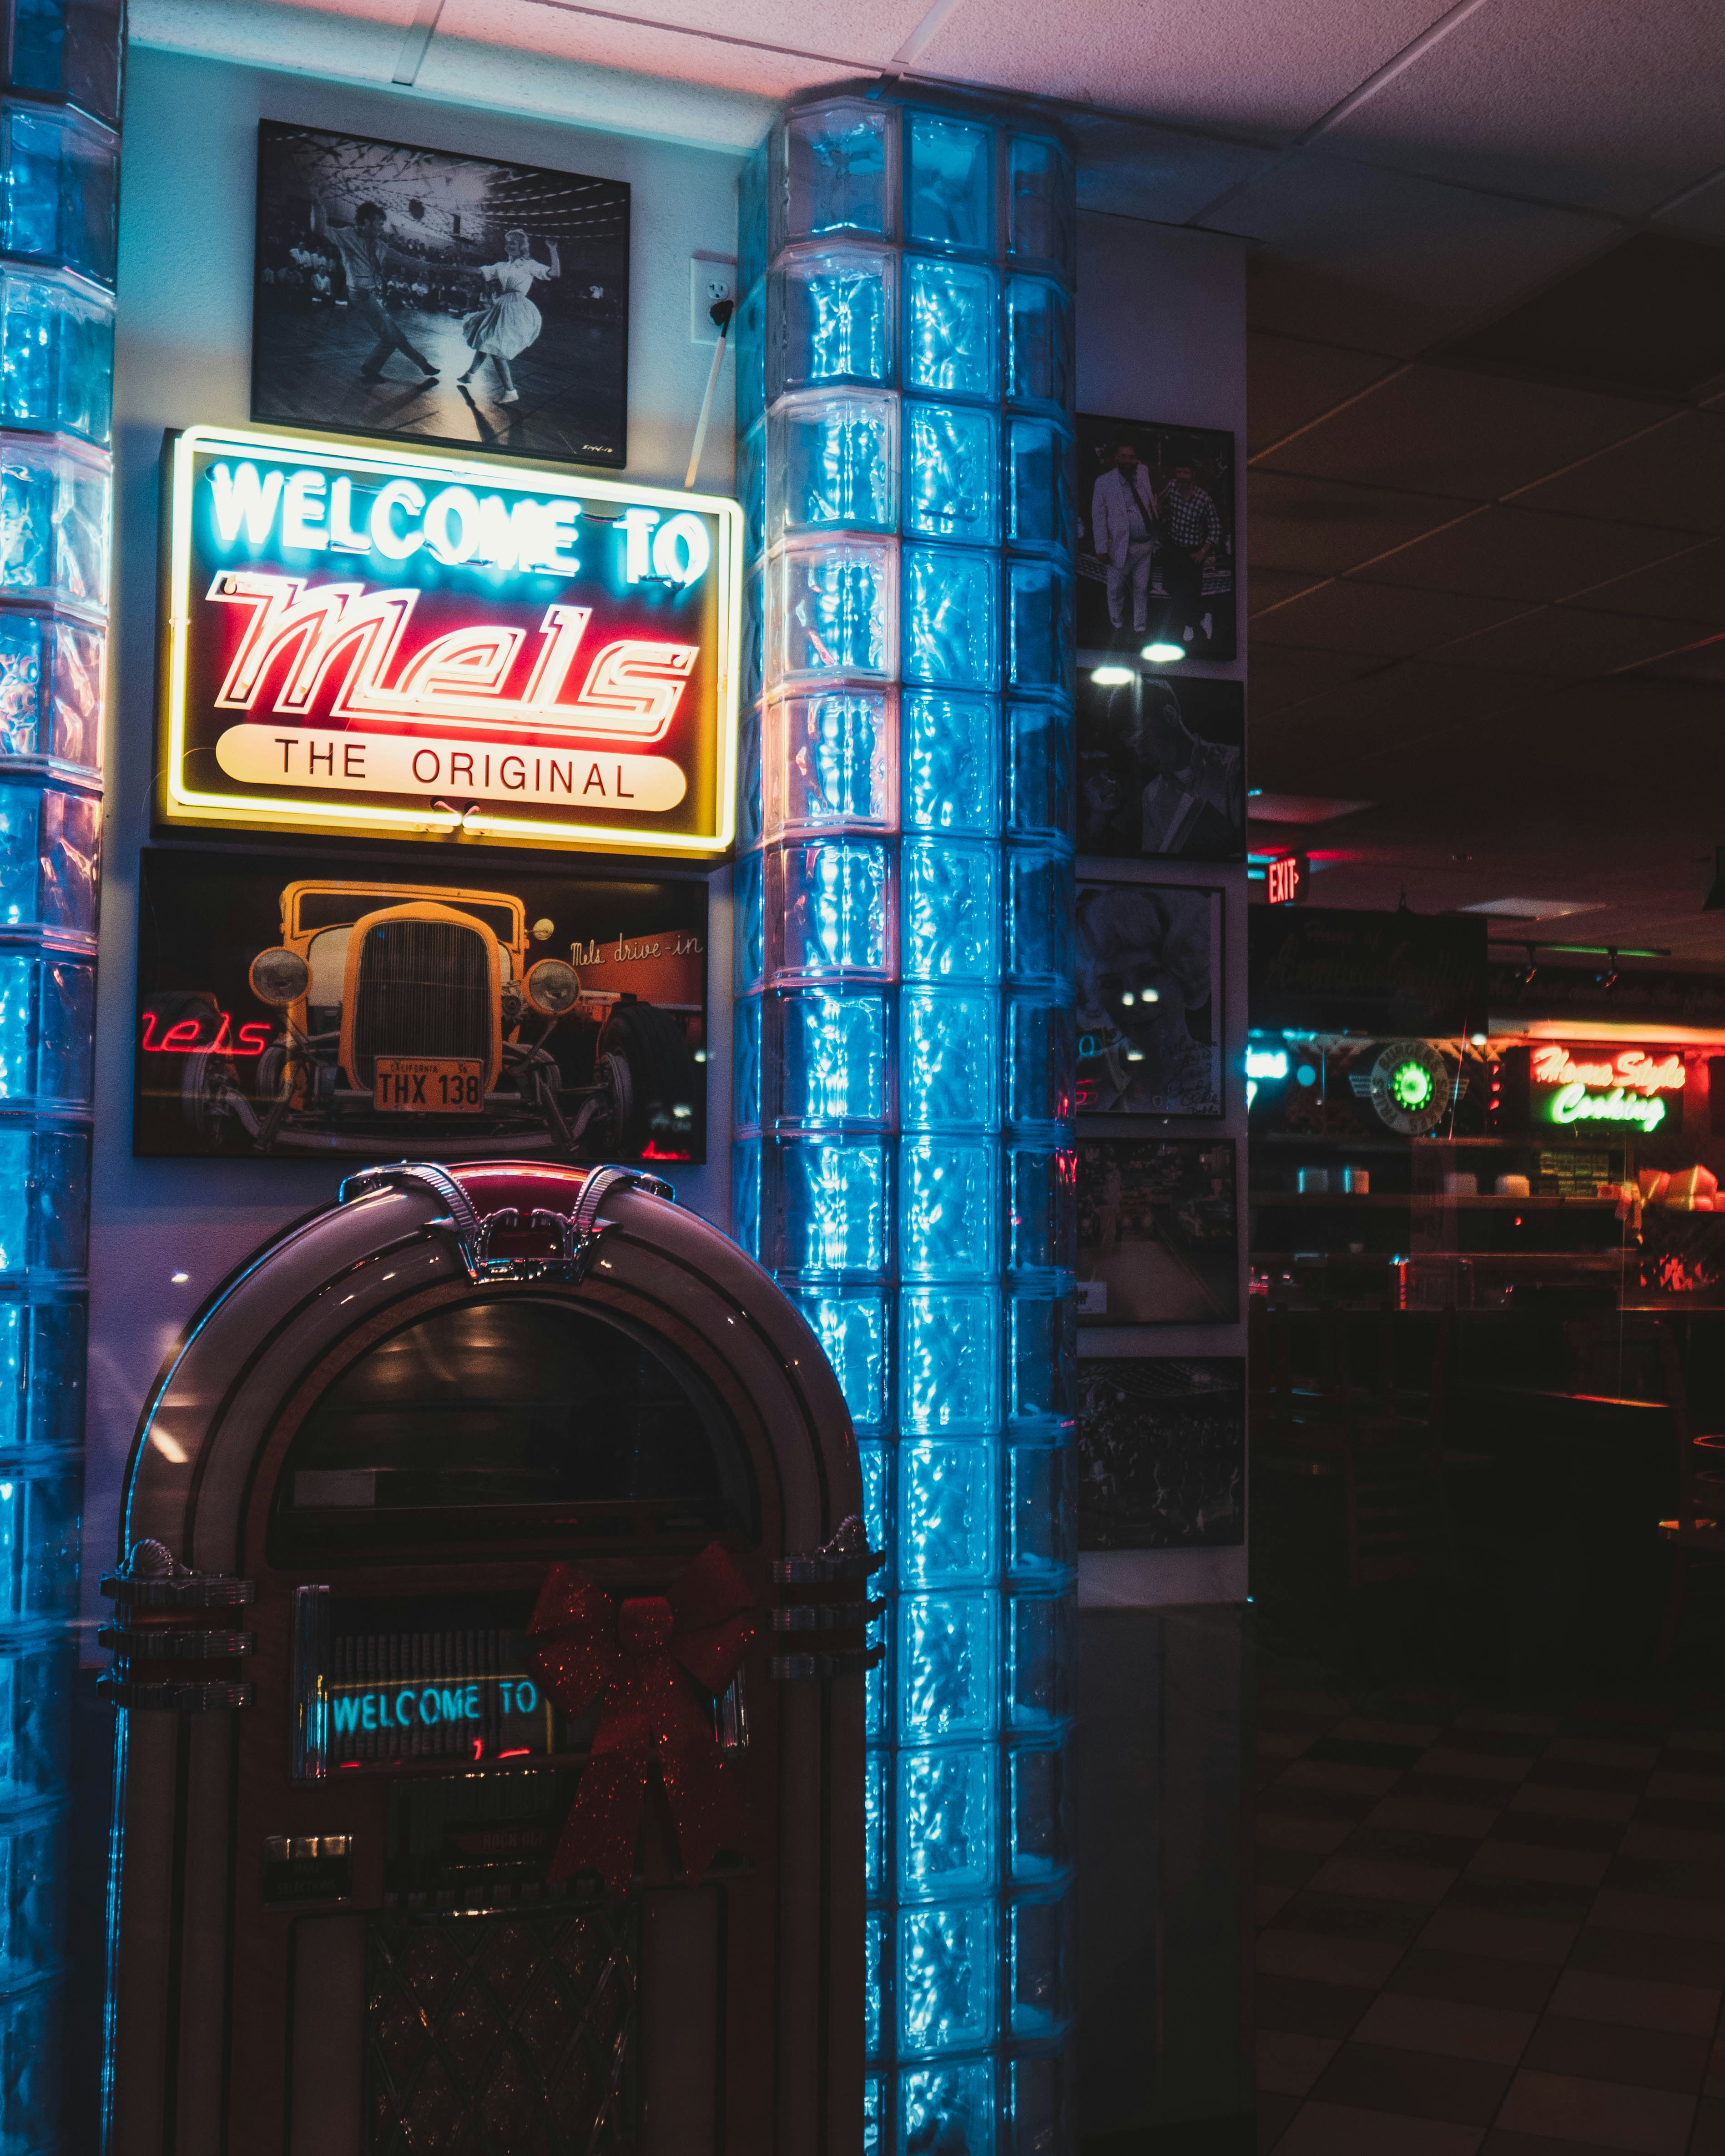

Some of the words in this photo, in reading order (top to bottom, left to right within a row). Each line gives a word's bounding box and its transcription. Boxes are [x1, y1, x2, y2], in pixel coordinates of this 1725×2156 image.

[207, 460, 585, 579] WELCOME
[614, 506, 712, 590] TO
[205, 569, 700, 744] Mels
[274, 737, 367, 780] THE
[411, 747, 636, 799] ORIGINAL
[1267, 857, 1297, 904] EXIT
[570, 939, 606, 967] Mels
[614, 932, 703, 962] drive-in
[379, 1073, 426, 1104] THX
[438, 1074, 479, 1105] 138
[390, 1063, 438, 1073] CALIFORNIA
[1533, 1046, 1614, 1087] Home
[1613, 1050, 1686, 1097] Style
[1552, 1082, 1665, 1133] Cooking
[333, 1684, 480, 1735] WELCOME
[499, 1681, 537, 1713] TO
